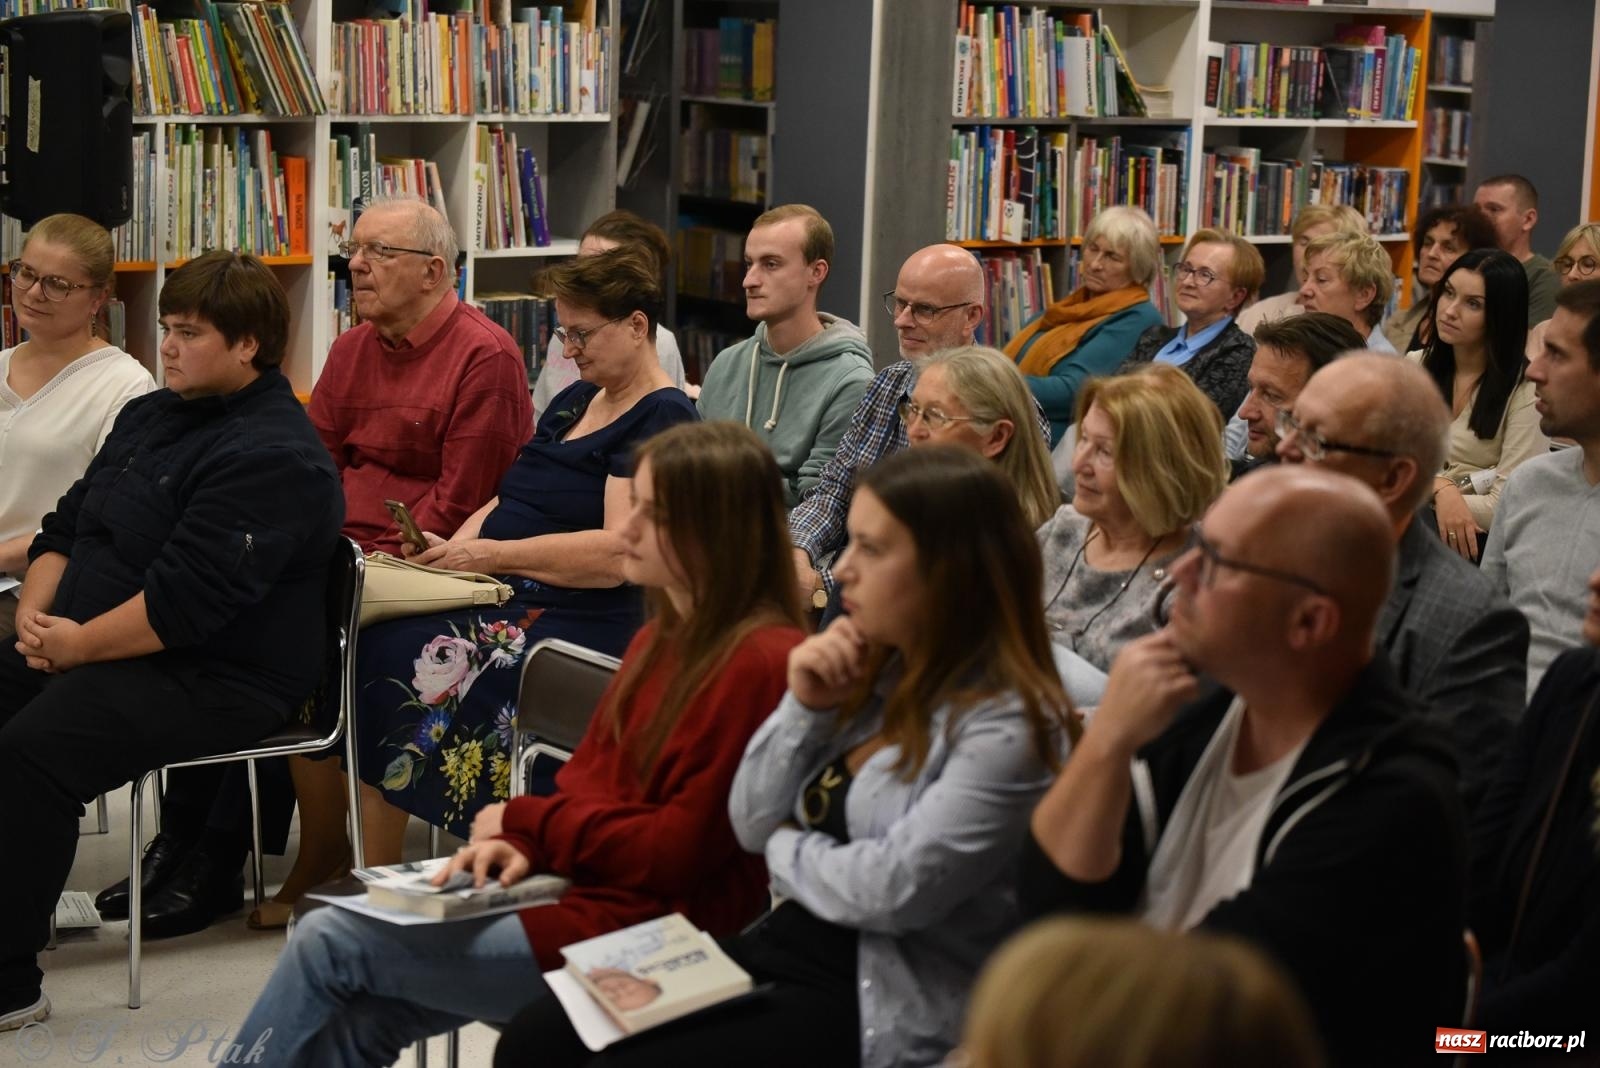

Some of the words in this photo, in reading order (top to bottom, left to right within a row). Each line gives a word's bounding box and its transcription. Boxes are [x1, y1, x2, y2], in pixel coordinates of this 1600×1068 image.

[957, 59, 965, 113] EKOLOGIA
[945, 165, 956, 210] SPORT
[475, 184, 483, 249] DINOZAURY
